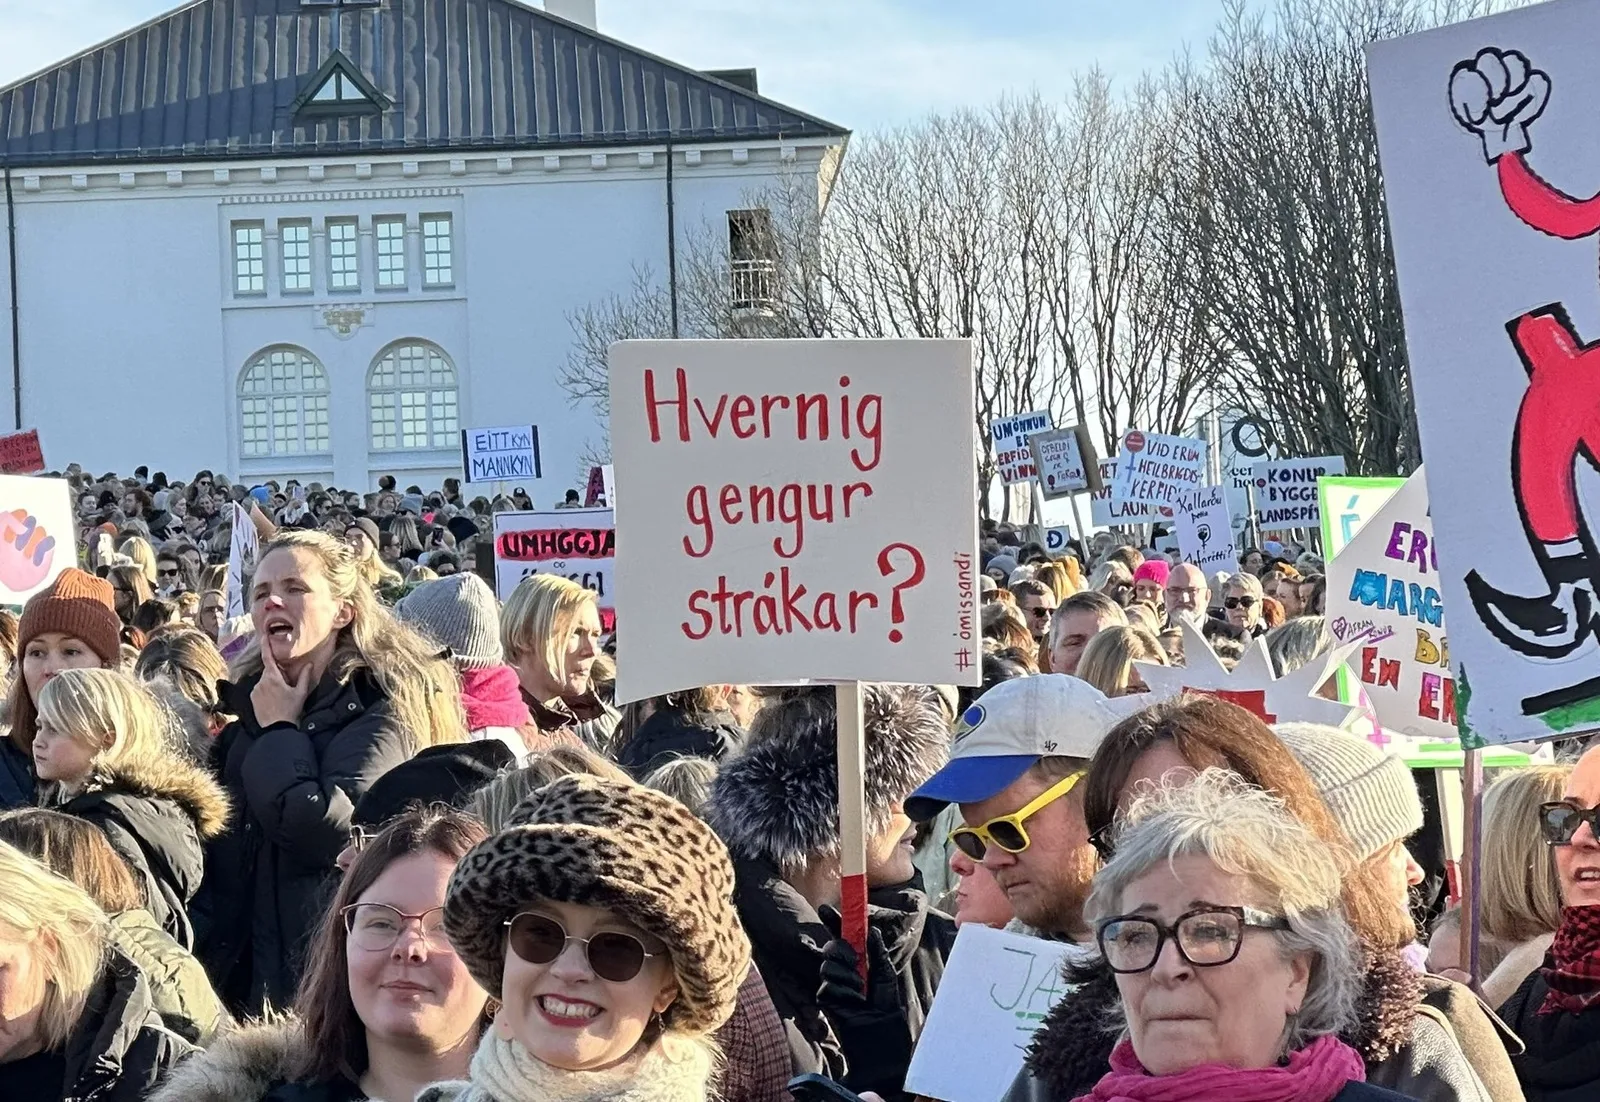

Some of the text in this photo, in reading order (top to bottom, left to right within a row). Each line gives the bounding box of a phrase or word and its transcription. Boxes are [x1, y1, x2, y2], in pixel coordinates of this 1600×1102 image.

[511, 433, 531, 448] KYN
[644, 367, 883, 472] Hvernig
[472, 454, 534, 478] MANNKYN
[682, 481, 874, 559] gengur
[681, 542, 926, 643] strákar?
[1360, 646, 1401, 691] EN
